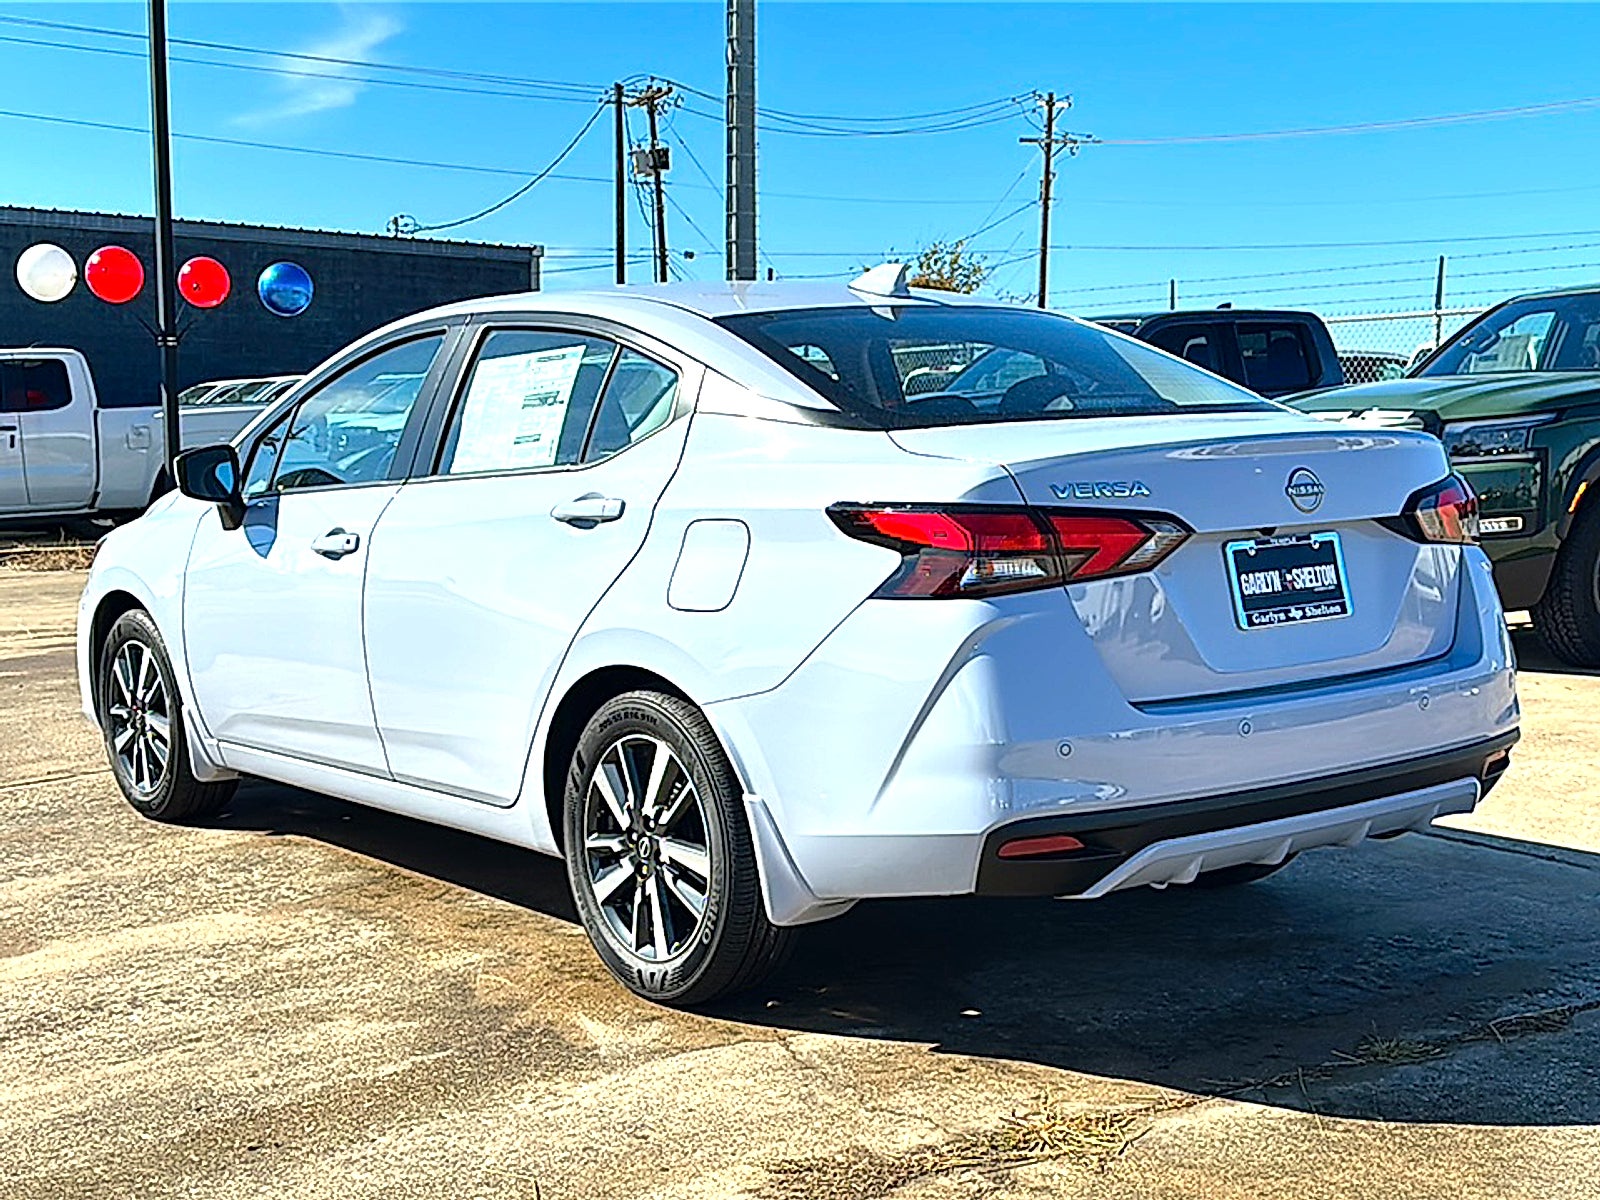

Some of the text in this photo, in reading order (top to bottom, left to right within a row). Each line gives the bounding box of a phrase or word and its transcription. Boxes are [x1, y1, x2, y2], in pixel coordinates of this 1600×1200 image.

[1049, 480, 1152, 500] VERSA
[1287, 484, 1324, 496] NISSAN
[1291, 563, 1338, 590] SHELTON
[1304, 604, 1342, 618] Shelton
